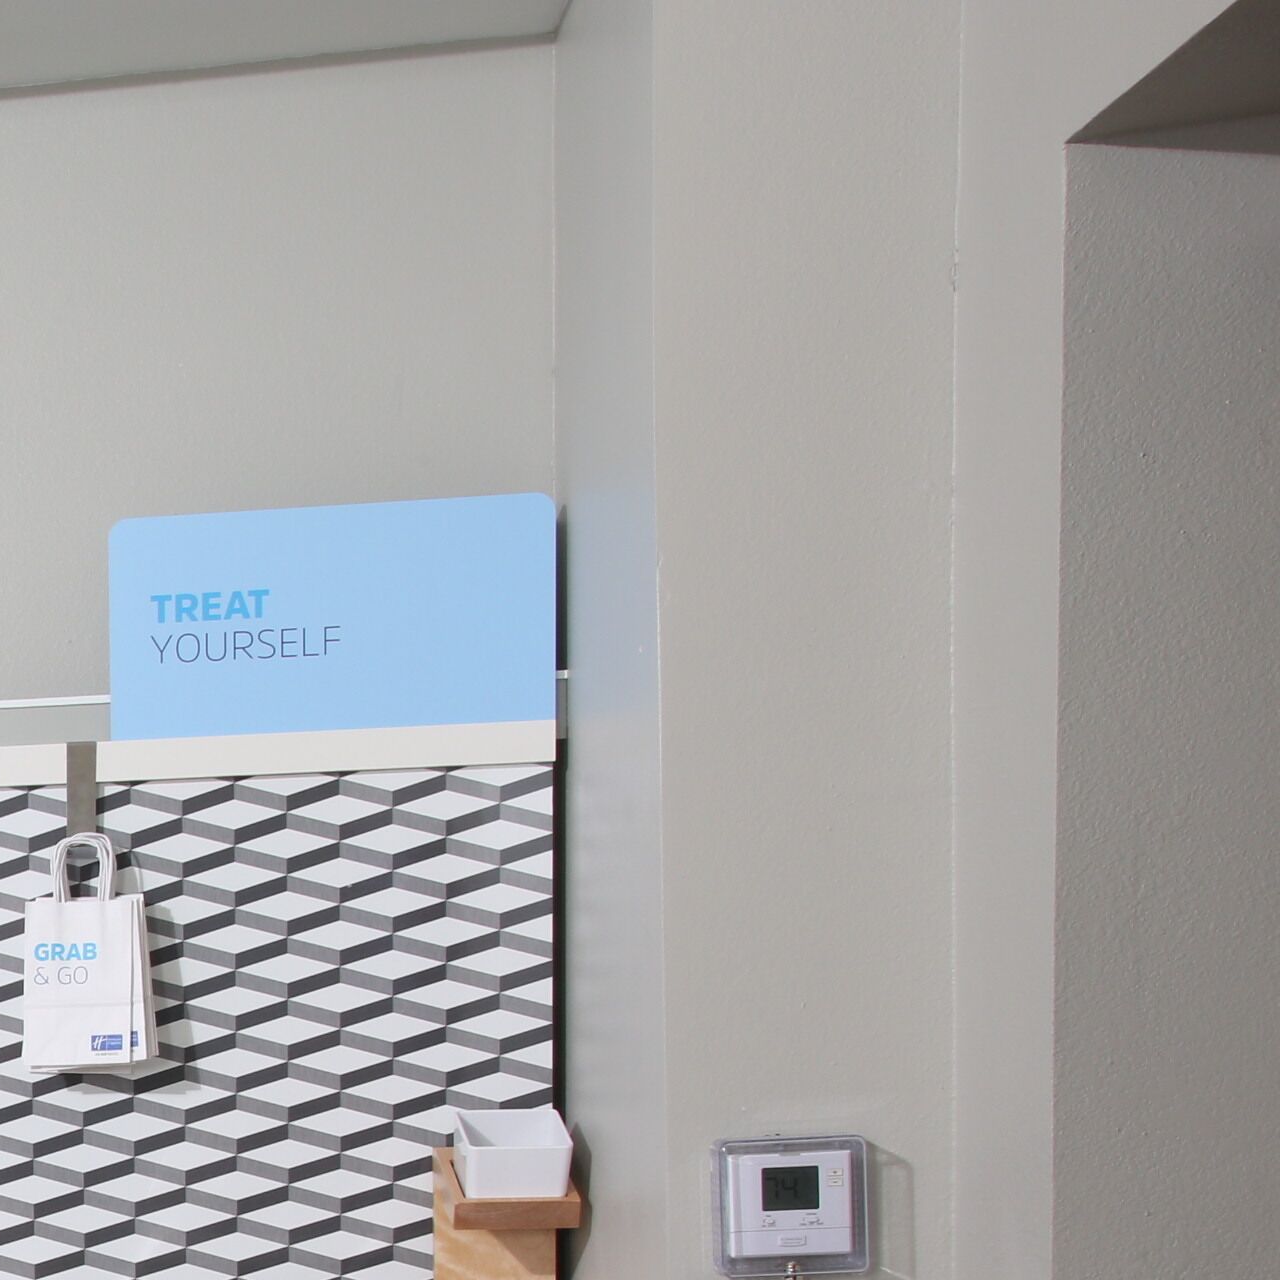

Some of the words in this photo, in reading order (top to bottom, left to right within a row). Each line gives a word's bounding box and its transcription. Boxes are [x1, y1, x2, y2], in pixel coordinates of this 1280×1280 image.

[150, 589, 270, 624] TREAT
[150, 625, 341, 665] YOURSELF
[33, 942, 98, 962] GRAB
[33, 966, 50, 986] &
[57, 965, 89, 986] GO
